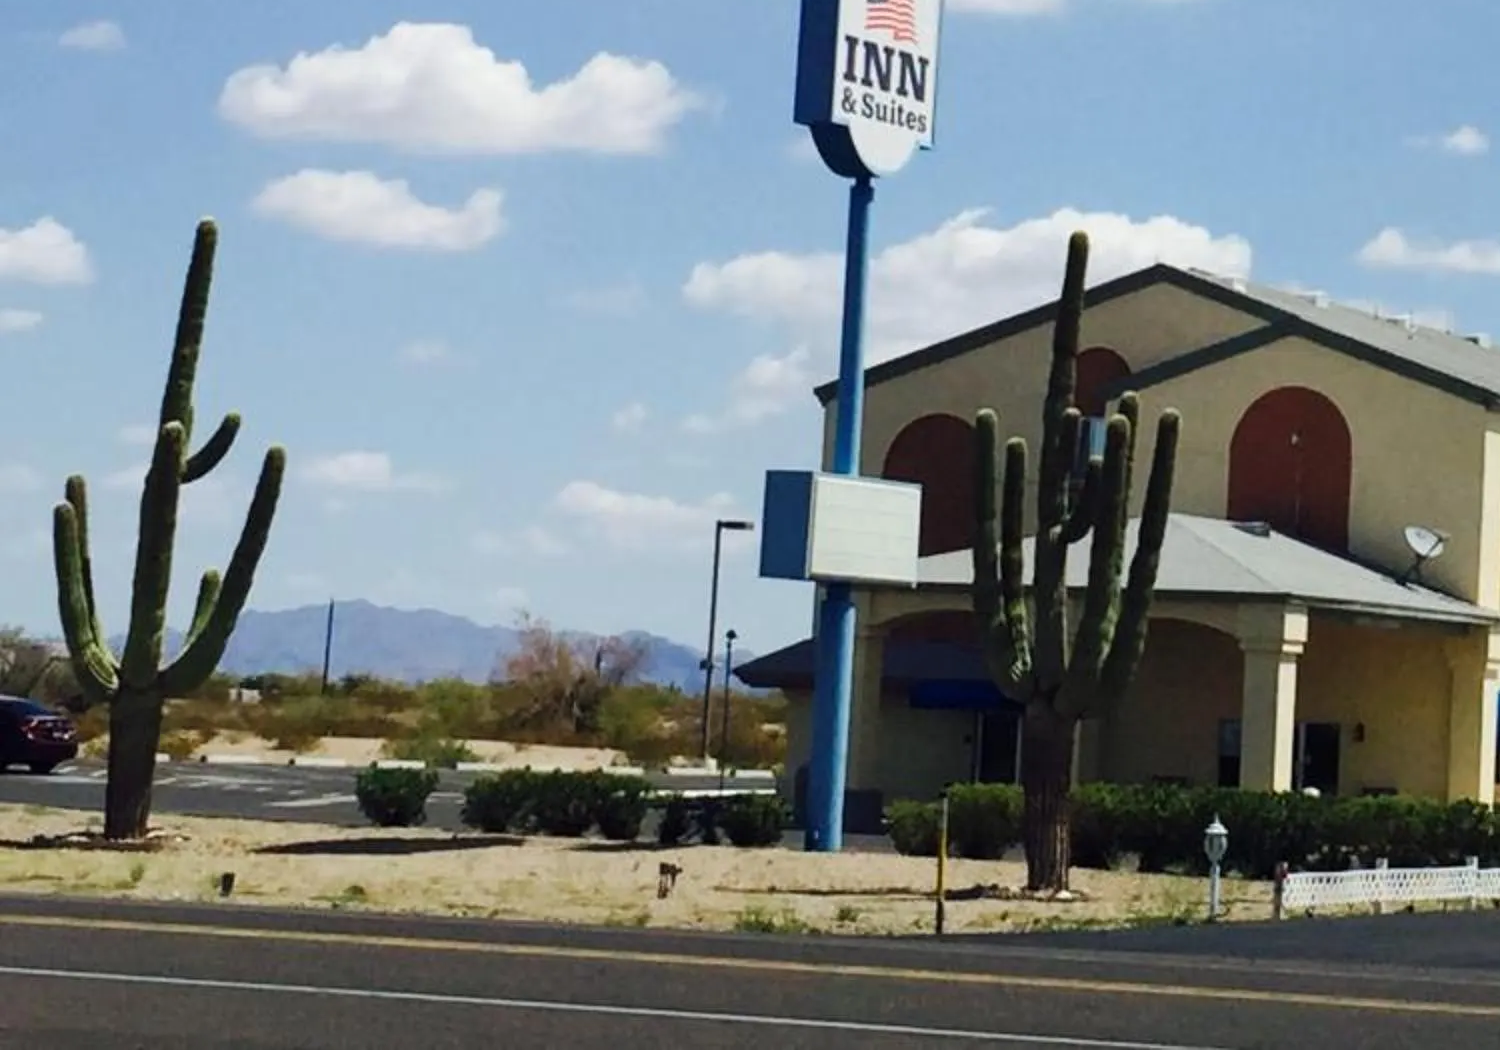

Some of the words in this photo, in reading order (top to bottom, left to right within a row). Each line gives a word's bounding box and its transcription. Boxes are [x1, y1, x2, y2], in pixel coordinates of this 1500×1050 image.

[843, 34, 929, 103] INN
[841, 86, 857, 115] &
[861, 93, 927, 133] Suites
